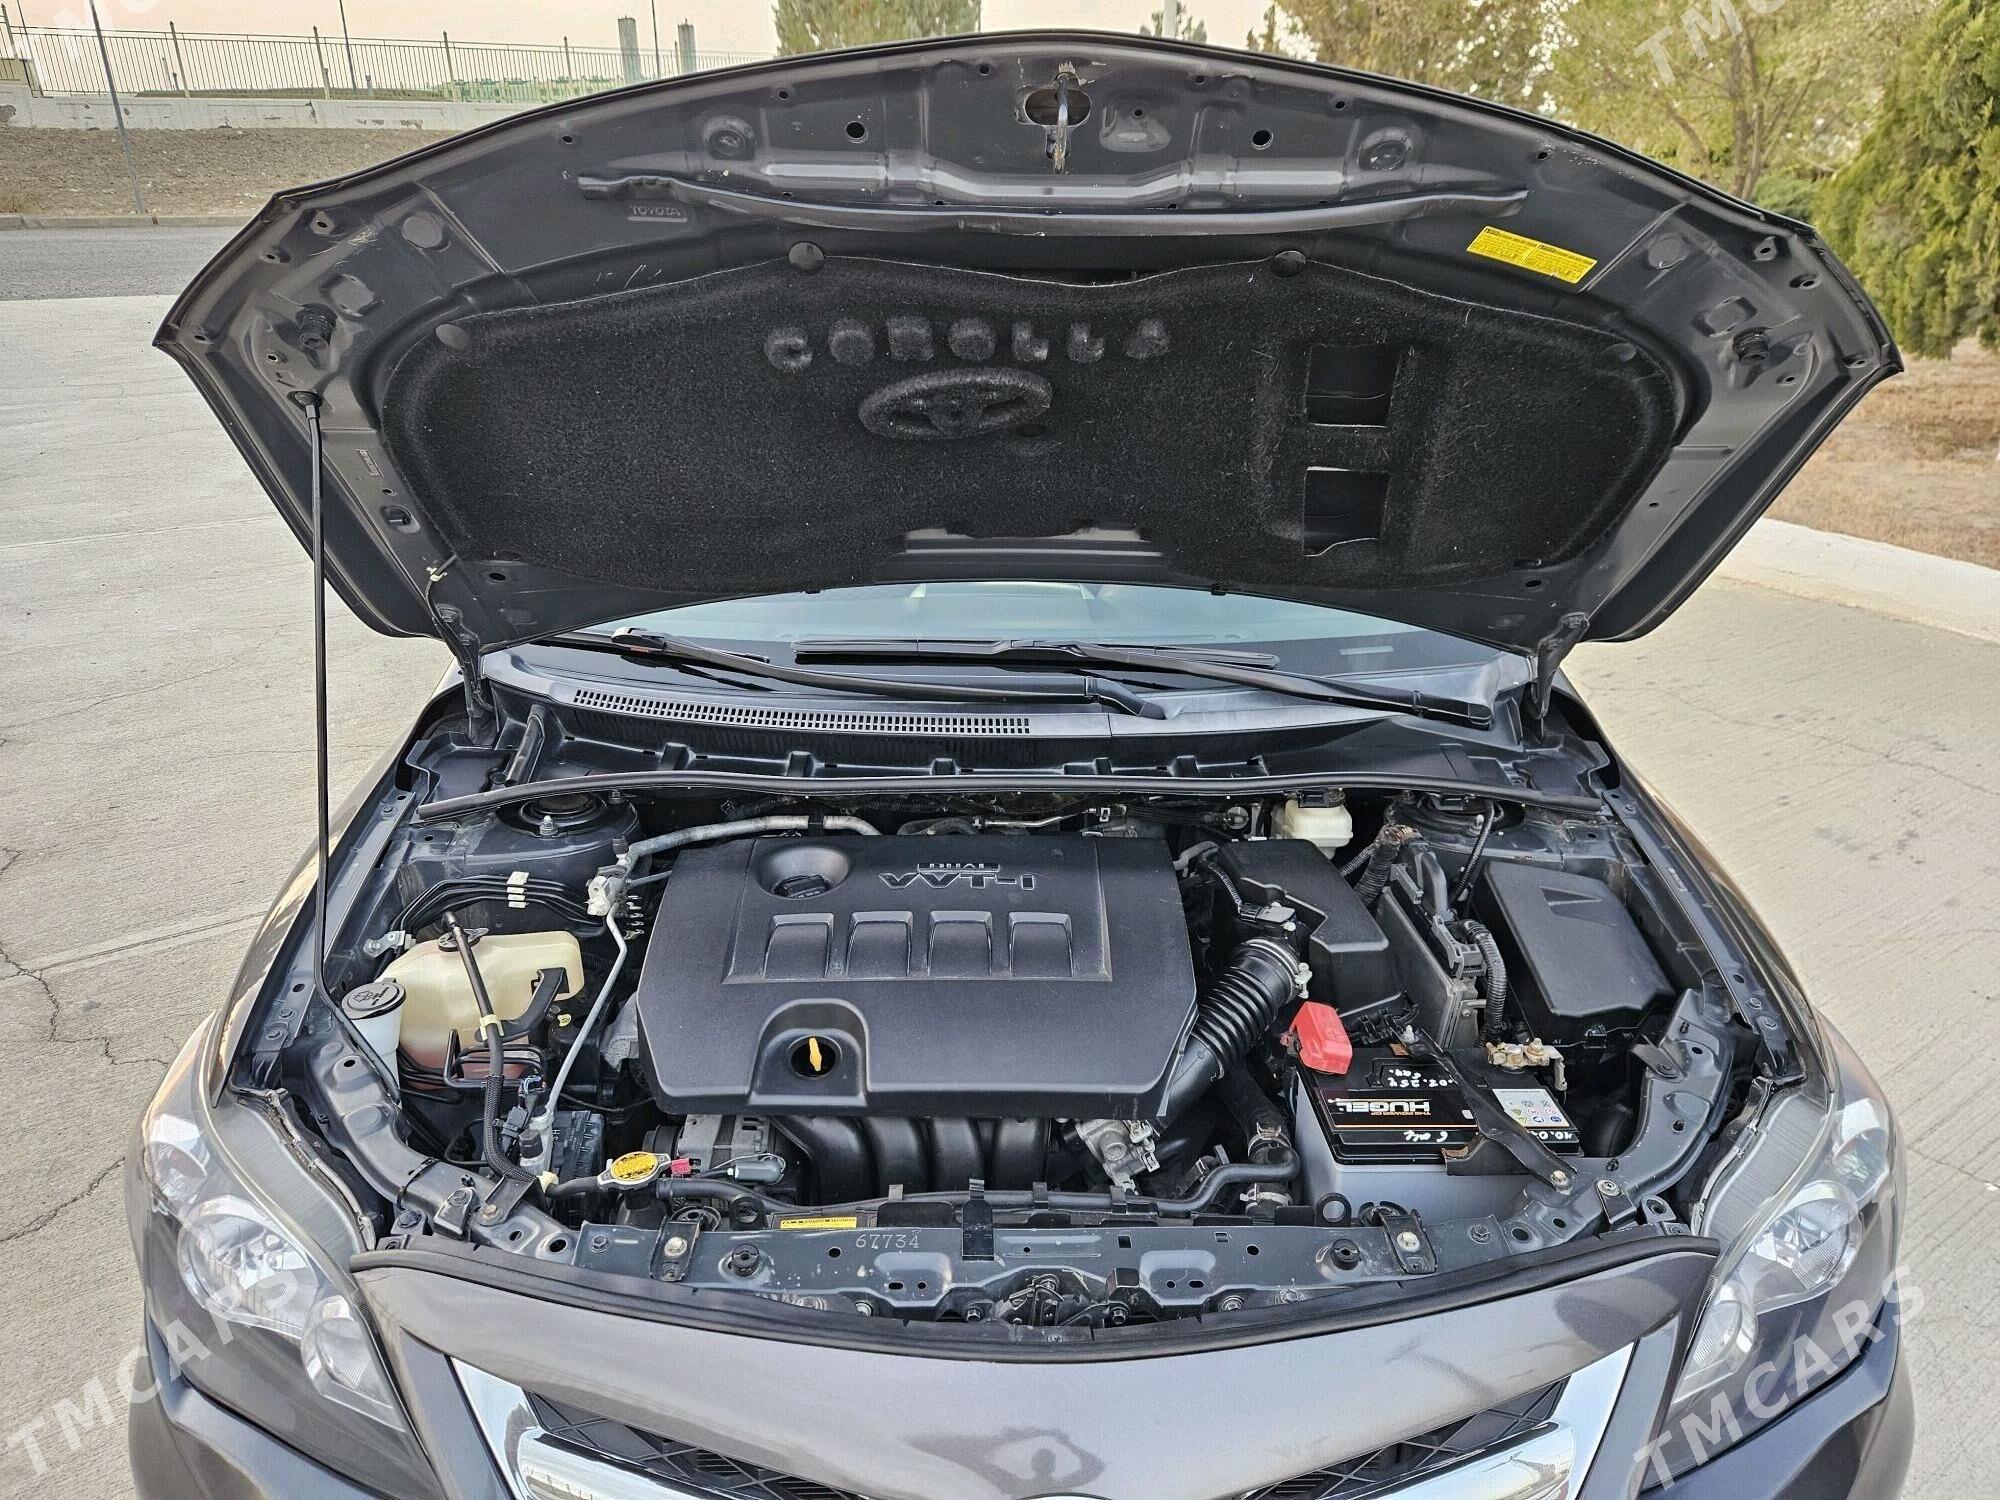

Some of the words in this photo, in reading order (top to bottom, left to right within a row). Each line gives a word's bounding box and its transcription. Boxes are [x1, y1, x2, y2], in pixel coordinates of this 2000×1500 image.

[632, 206, 681, 216] TOYOTA
[1336, 1101, 1430, 1113] HUGEL
[855, 1231, 921, 1249] 67734
